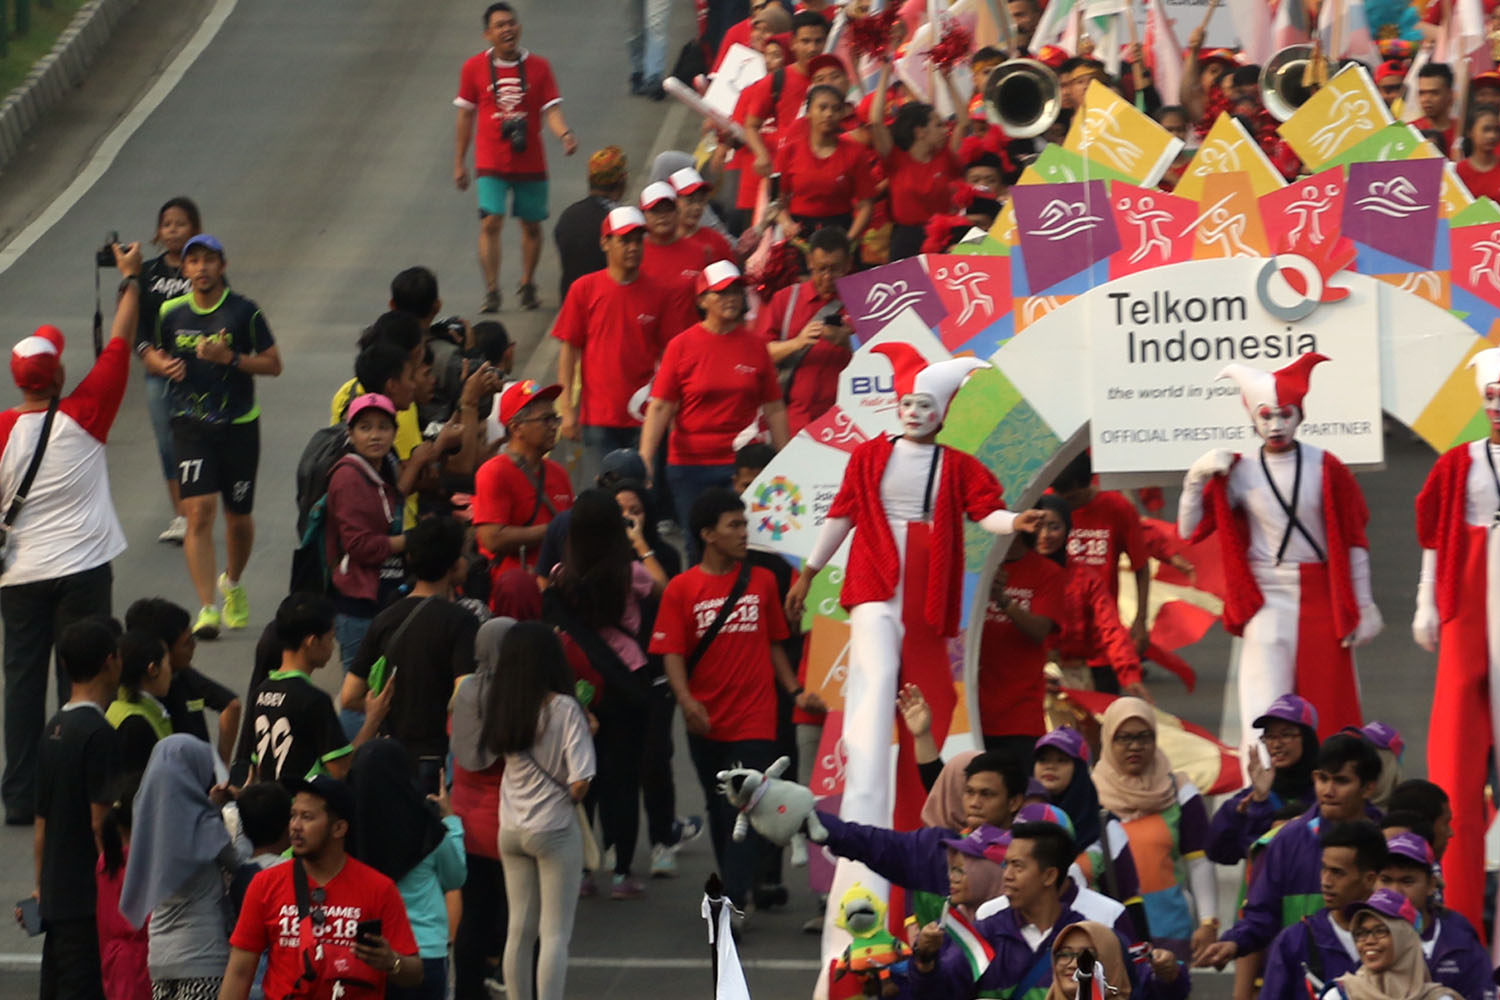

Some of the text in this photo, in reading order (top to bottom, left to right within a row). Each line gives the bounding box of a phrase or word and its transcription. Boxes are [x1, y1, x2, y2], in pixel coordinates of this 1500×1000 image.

[1108, 290, 1247, 325] Telkom
[1128, 326, 1317, 363] Indonesia
[1107, 386, 1134, 400] the
[1137, 385, 1183, 400] world
[1186, 384, 1201, 397] in
[1100, 427, 1170, 444] OFFICIAL
[1173, 424, 1246, 441] PRESTIGE
[1302, 420, 1373, 436] PARTNER
